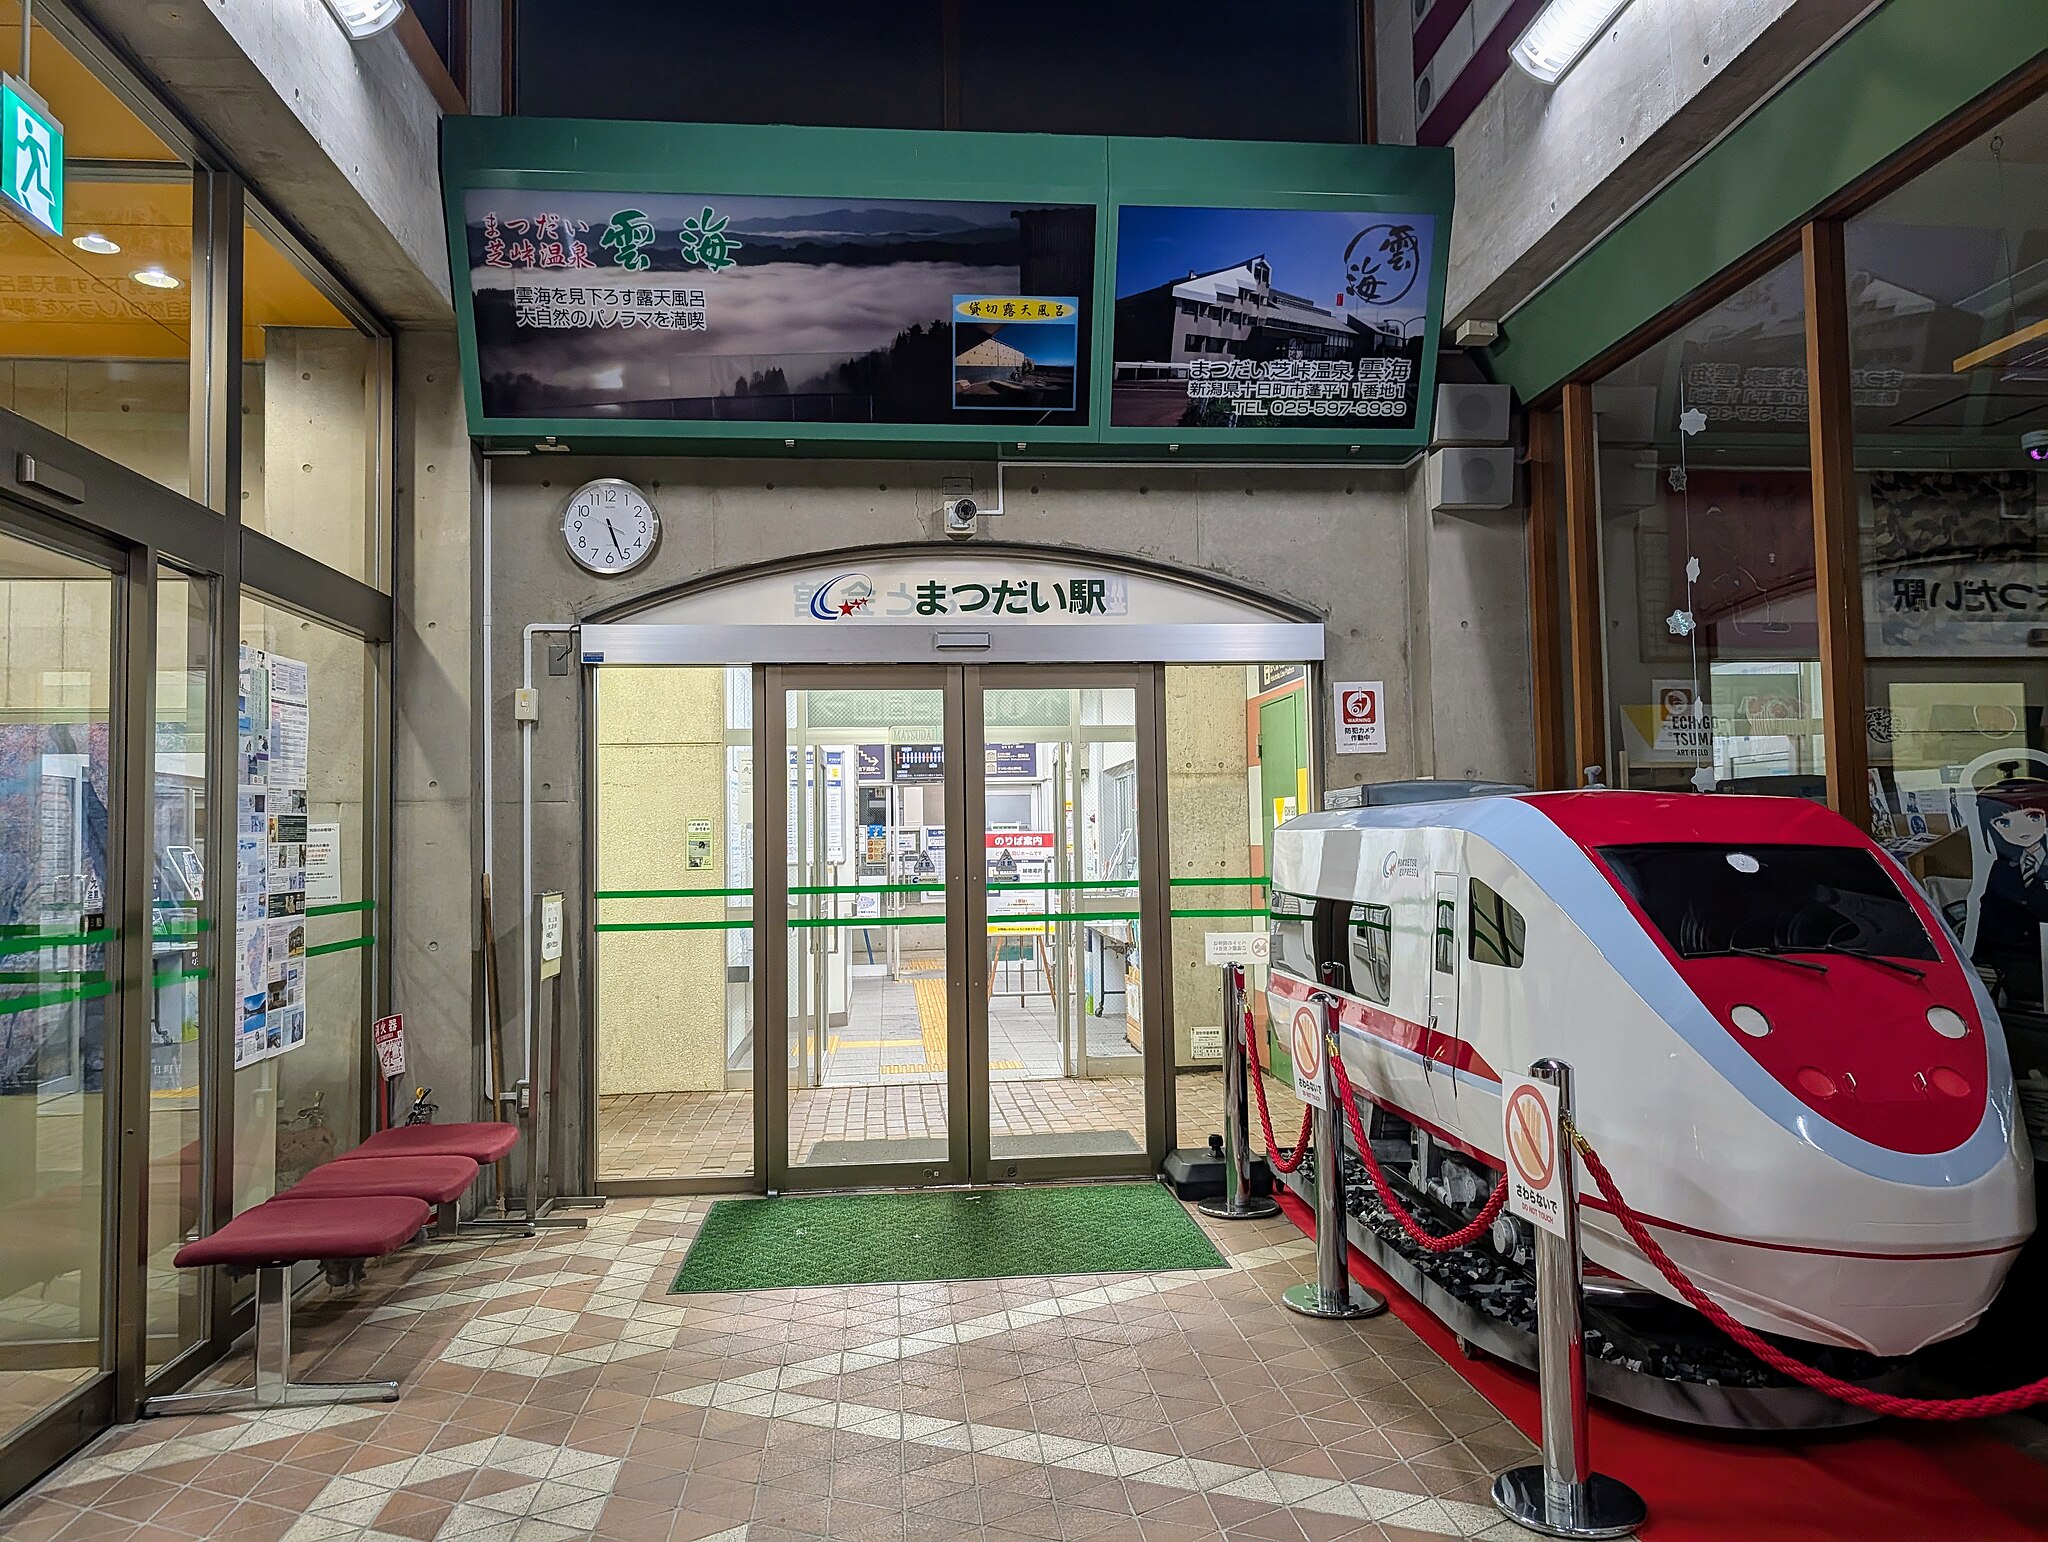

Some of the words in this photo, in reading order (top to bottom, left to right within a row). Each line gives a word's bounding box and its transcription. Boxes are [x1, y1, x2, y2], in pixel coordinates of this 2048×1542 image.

[484, 212, 590, 239] まつだい
[485, 240, 597, 269] 芝峠温泉
[515, 287, 706, 308] 雲海を見下ろす露天風呂
[968, 301, 1065, 318] 貸切露天風呂
[515, 308, 707, 331] 大自然のパノラマを満喫
[1189, 359, 1354, 381] まつだい芝峠温泉
[1358, 358, 1412, 381] 雲海
[1232, 400, 1269, 416] TEL
[1270, 400, 1408, 417] 025-597-3939
[590, 493, 600, 506] 11
[604, 490, 617, 502] 12
[578, 505, 590, 517] 10
[633, 505, 643, 518] 2
[573, 520, 583, 533] 9
[638, 521, 647, 534] 3
[578, 536, 587, 548] 8
[632, 537, 642, 548] 4
[590, 548, 599, 559] 7
[605, 552, 615, 564] 6
[915, 578, 1107, 616] まつだい駅
[1344, 726, 1376, 735] 防犯カメラ
[1350, 734, 1371, 742] 作動中
[994, 835, 1043, 846] のりば案内
[1515, 1183, 1558, 1215] さわらないで
[1521, 1201, 1529, 1211] DO
[1529, 1205, 1538, 1217] NOT
[1537, 1210, 1554, 1225] TOUCH
